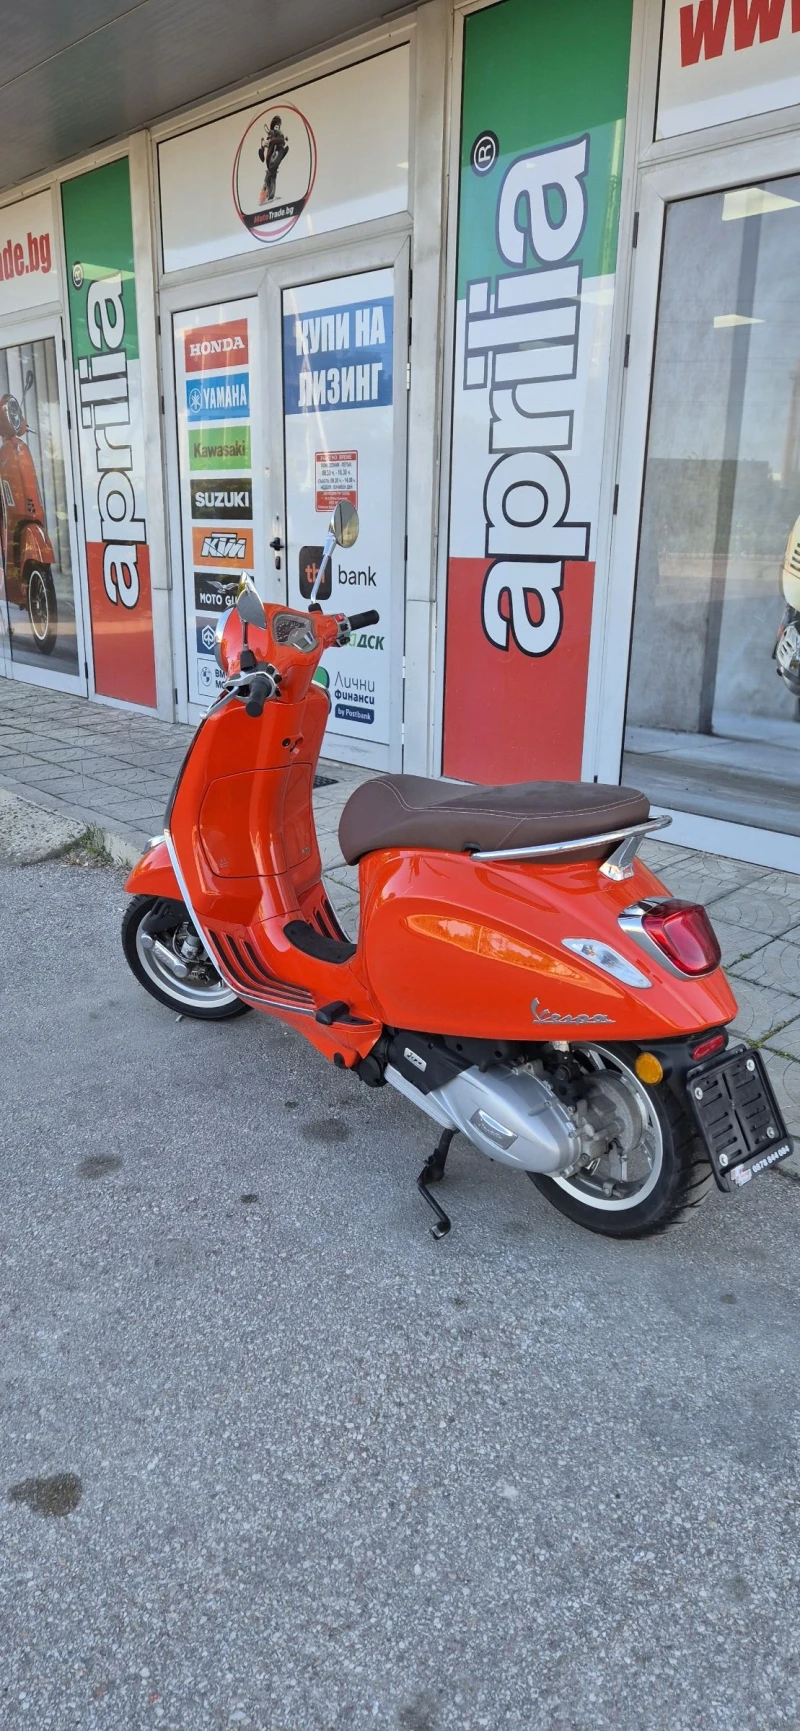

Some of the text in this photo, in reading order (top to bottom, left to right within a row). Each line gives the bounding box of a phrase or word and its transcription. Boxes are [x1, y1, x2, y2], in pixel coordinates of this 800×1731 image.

[680, 0, 800, 67] ww
[253, 206, 294, 224] MotoTrade.bg
[0, 232, 52, 281] de.bg
[295, 305, 386, 356] КУПИ НА
[190, 336, 245, 357] HONDA
[298, 362, 383, 407] ЛИЗИНГ
[463, 133, 590, 658] aprilia
[202, 383, 247, 410] YAMAHA
[78, 269, 147, 610] aprilia
[194, 440, 246, 459] Kawasaki
[195, 491, 249, 508] SUZUKI
[200, 532, 247, 559] KTM
[338, 564, 377, 587] bank
[199, 592, 222, 605] MOTO
[357, 633, 385, 650] ДСК
[214, 668, 226, 678] BM
[334, 671, 375, 693] Лични
[338, 708, 371, 721] by Postbank
[531, 997, 616, 1025] Vespa
